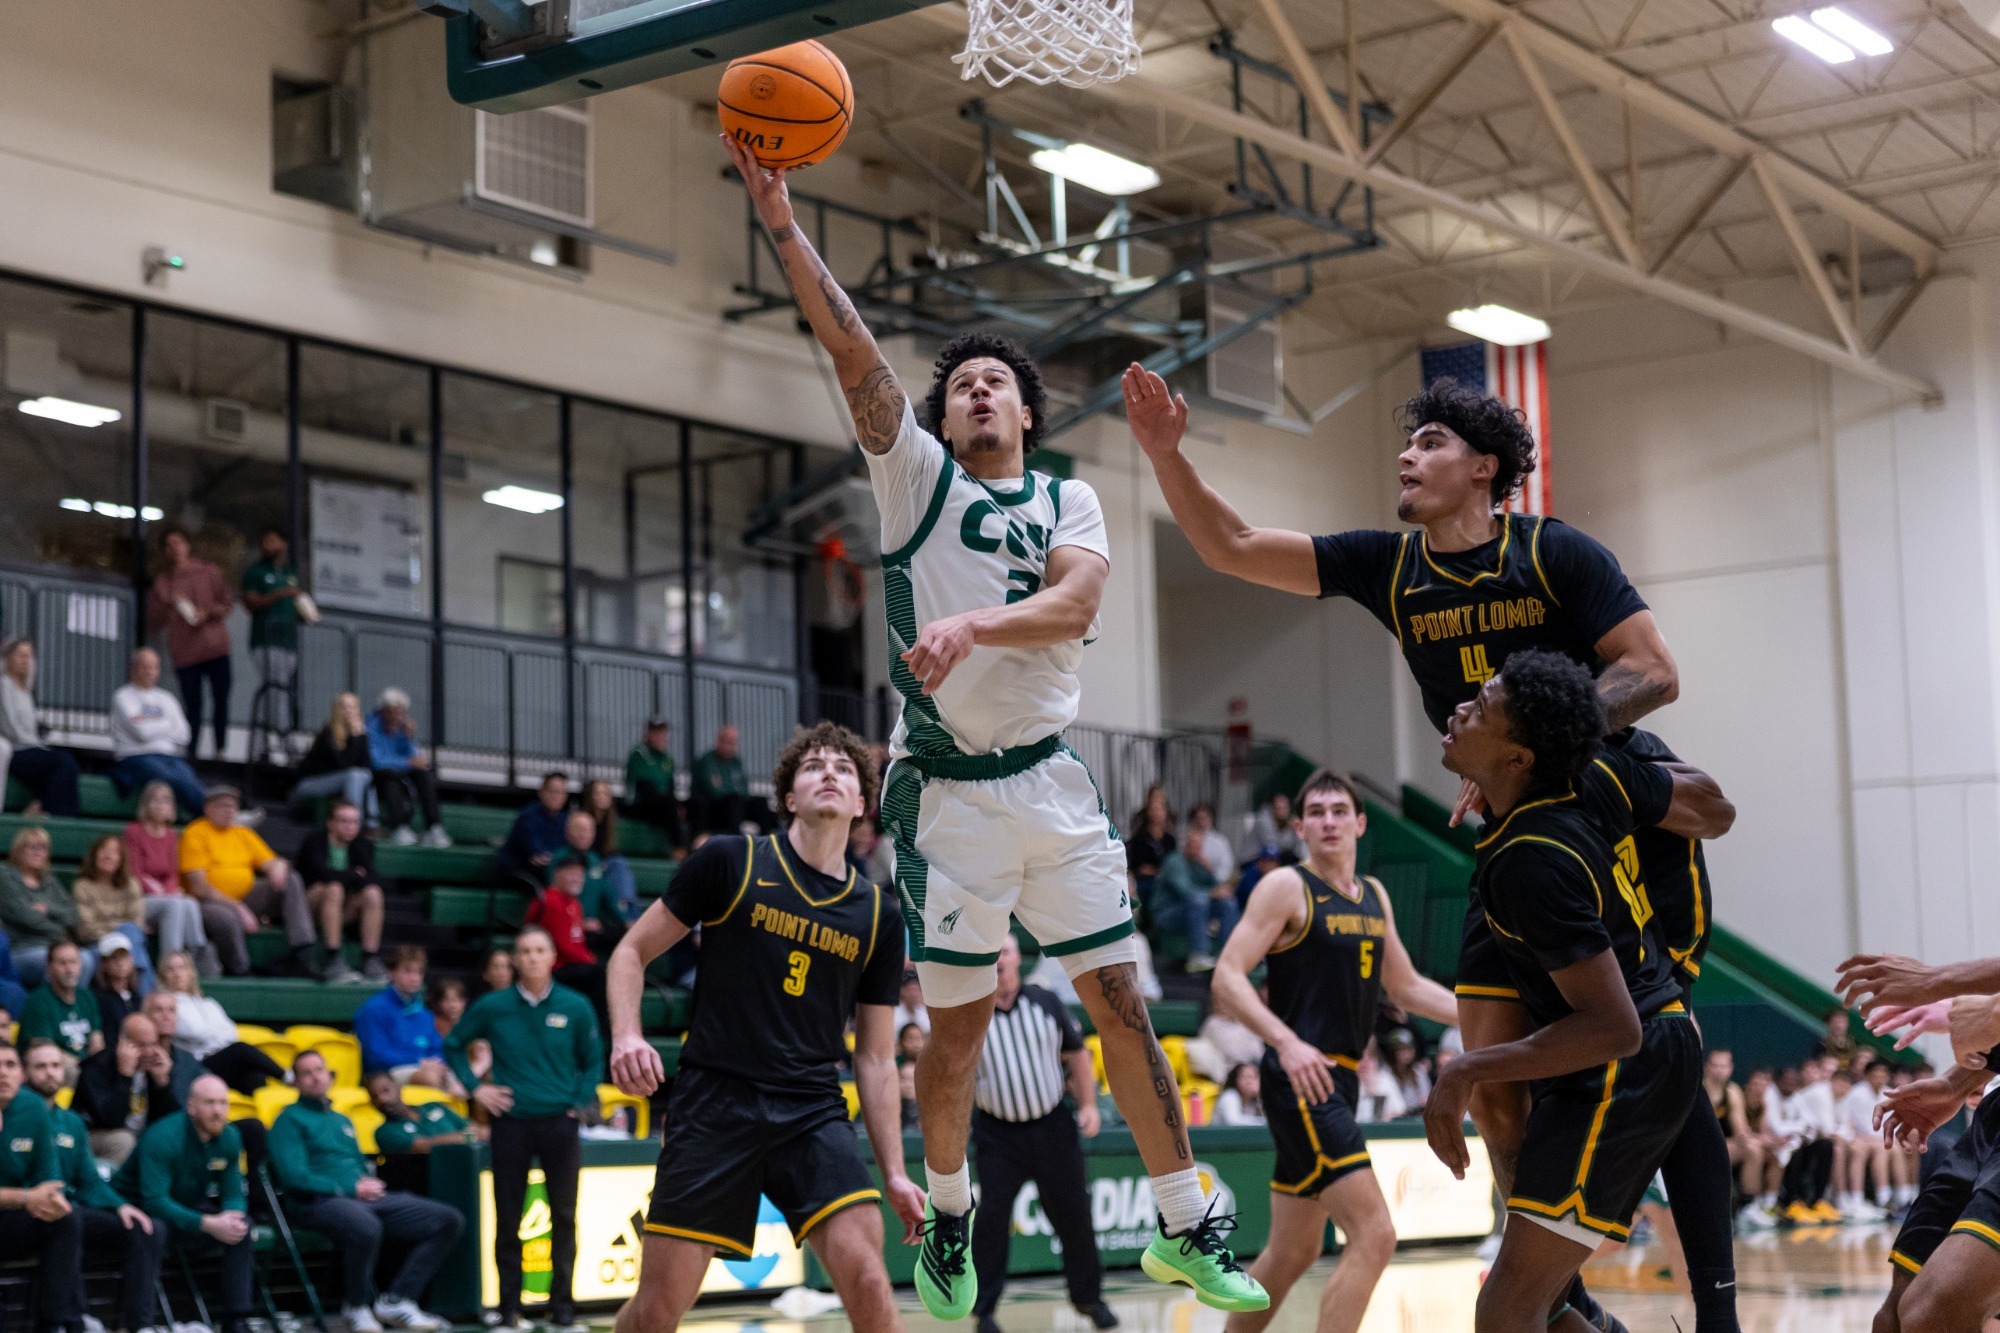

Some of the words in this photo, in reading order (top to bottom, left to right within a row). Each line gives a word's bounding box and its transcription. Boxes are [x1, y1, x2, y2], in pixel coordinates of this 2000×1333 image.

[1410, 605, 1474, 644] POINT
[1478, 597, 1546, 632] LOMA
[1459, 644, 1496, 687] 4
[750, 903, 810, 942] POINT
[808, 922, 861, 962] LOMA
[783, 950, 811, 997] 3
[1360, 940, 1374, 979] 5
